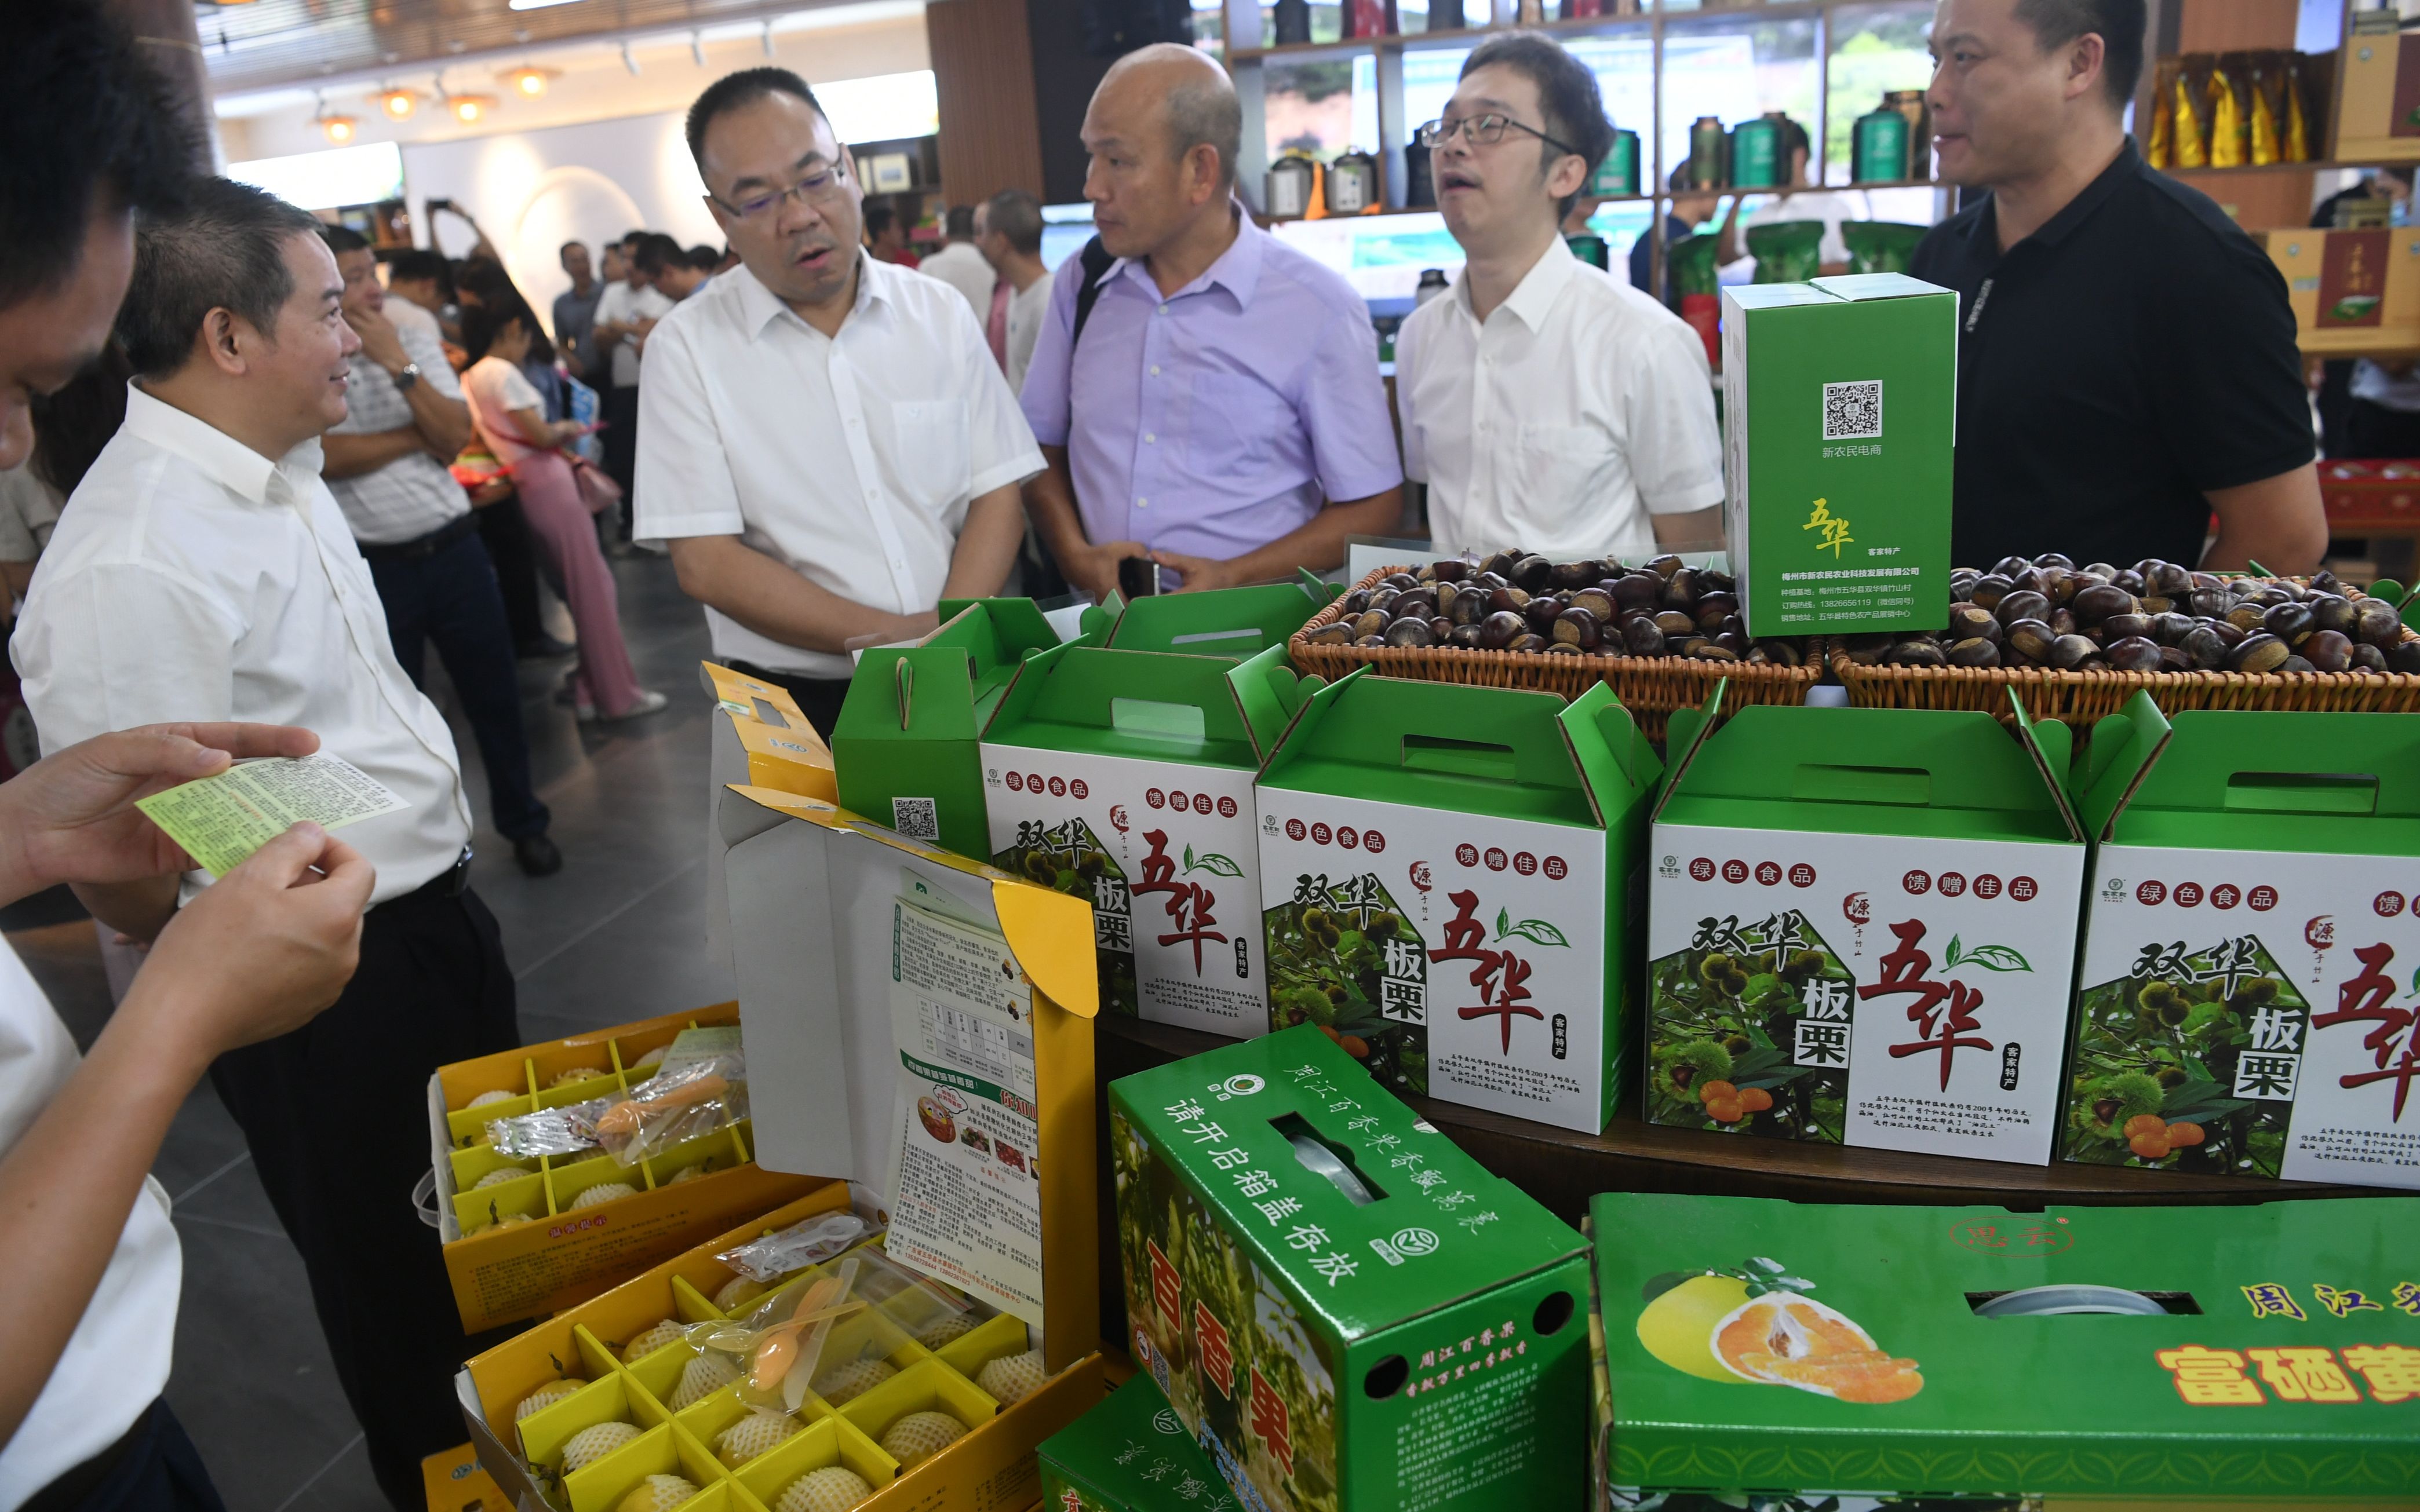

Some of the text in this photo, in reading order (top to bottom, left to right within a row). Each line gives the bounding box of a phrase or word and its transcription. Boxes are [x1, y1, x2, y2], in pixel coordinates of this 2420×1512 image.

[1821, 444, 1882, 458] 新农民电商
[1802, 497, 1854, 560] 五华
[1868, 547, 1901, 556] 客家特产
[1781, 567, 1920, 581] 梅州市新农民农业科技发展有限公司
[1008, 773, 1087, 798] 绿色食品
[1148, 790, 1235, 815] 馈赠佳品
[1016, 816, 1094, 870] 双华
[1288, 821, 1383, 850] 绿色食品
[1459, 846, 1564, 877] 馈赠佳品
[1692, 861, 1813, 885] 绿色食品
[1907, 873, 2033, 897] 馈赠佳品
[1094, 875, 1134, 949] 板栗
[1129, 828, 1229, 978] 五华
[1293, 872, 1386, 931] 双华
[2140, 883, 2273, 907] 绿色食品
[2378, 894, 2420, 914] 馈
[1236, 940, 1248, 977] 客家特产
[1692, 909, 1809, 972] 双华
[1382, 938, 1424, 1021] 板栗
[1427, 889, 1544, 1057] 五华
[2130, 934, 2262, 1002] 双华
[1798, 978, 1849, 1065] 板栗
[1856, 918, 1994, 1093] 五华
[1554, 1017, 1566, 1056] 客家特产
[2236, 1006, 2303, 1097] 板栗
[2005, 1046, 2018, 1087] 客家特产
[1164, 1098, 1359, 1287] 请开启箱盖存放
[550, 1217, 606, 1238] 温馨提示
[1147, 1237, 1295, 1478] 百香果
[1419, 1320, 1515, 1370] 周江百香果
[2154, 1344, 2420, 1407] 富硒黄
